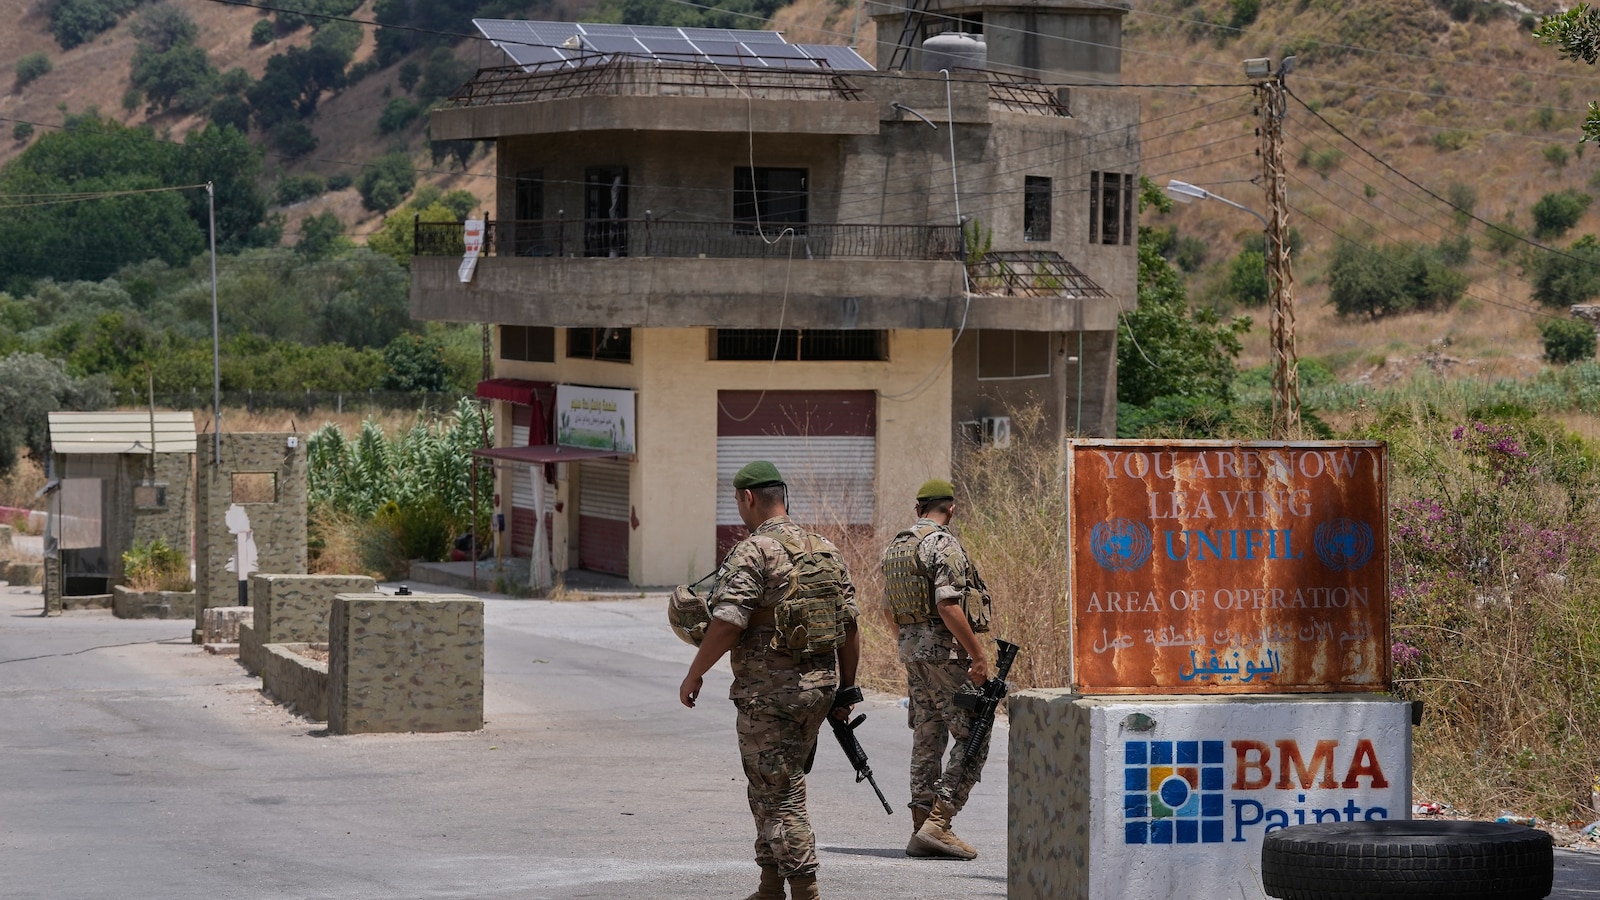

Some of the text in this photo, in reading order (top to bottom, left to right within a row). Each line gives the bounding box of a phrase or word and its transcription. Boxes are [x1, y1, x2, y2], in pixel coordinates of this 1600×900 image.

[1101, 451, 1362, 479] YOU ARE NOW
[1148, 490, 1313, 519] LEAVING
[1164, 529, 1304, 561] UNIFIL
[1086, 587, 1369, 613] AREA OF OPERATION
[1093, 628, 1135, 654] عمل
[1143, 625, 1206, 648] منطقة
[1213, 623, 1292, 650] تغادرون
[1179, 648, 1281, 682] اليونيفيل
[1231, 739, 1388, 790] BMA
